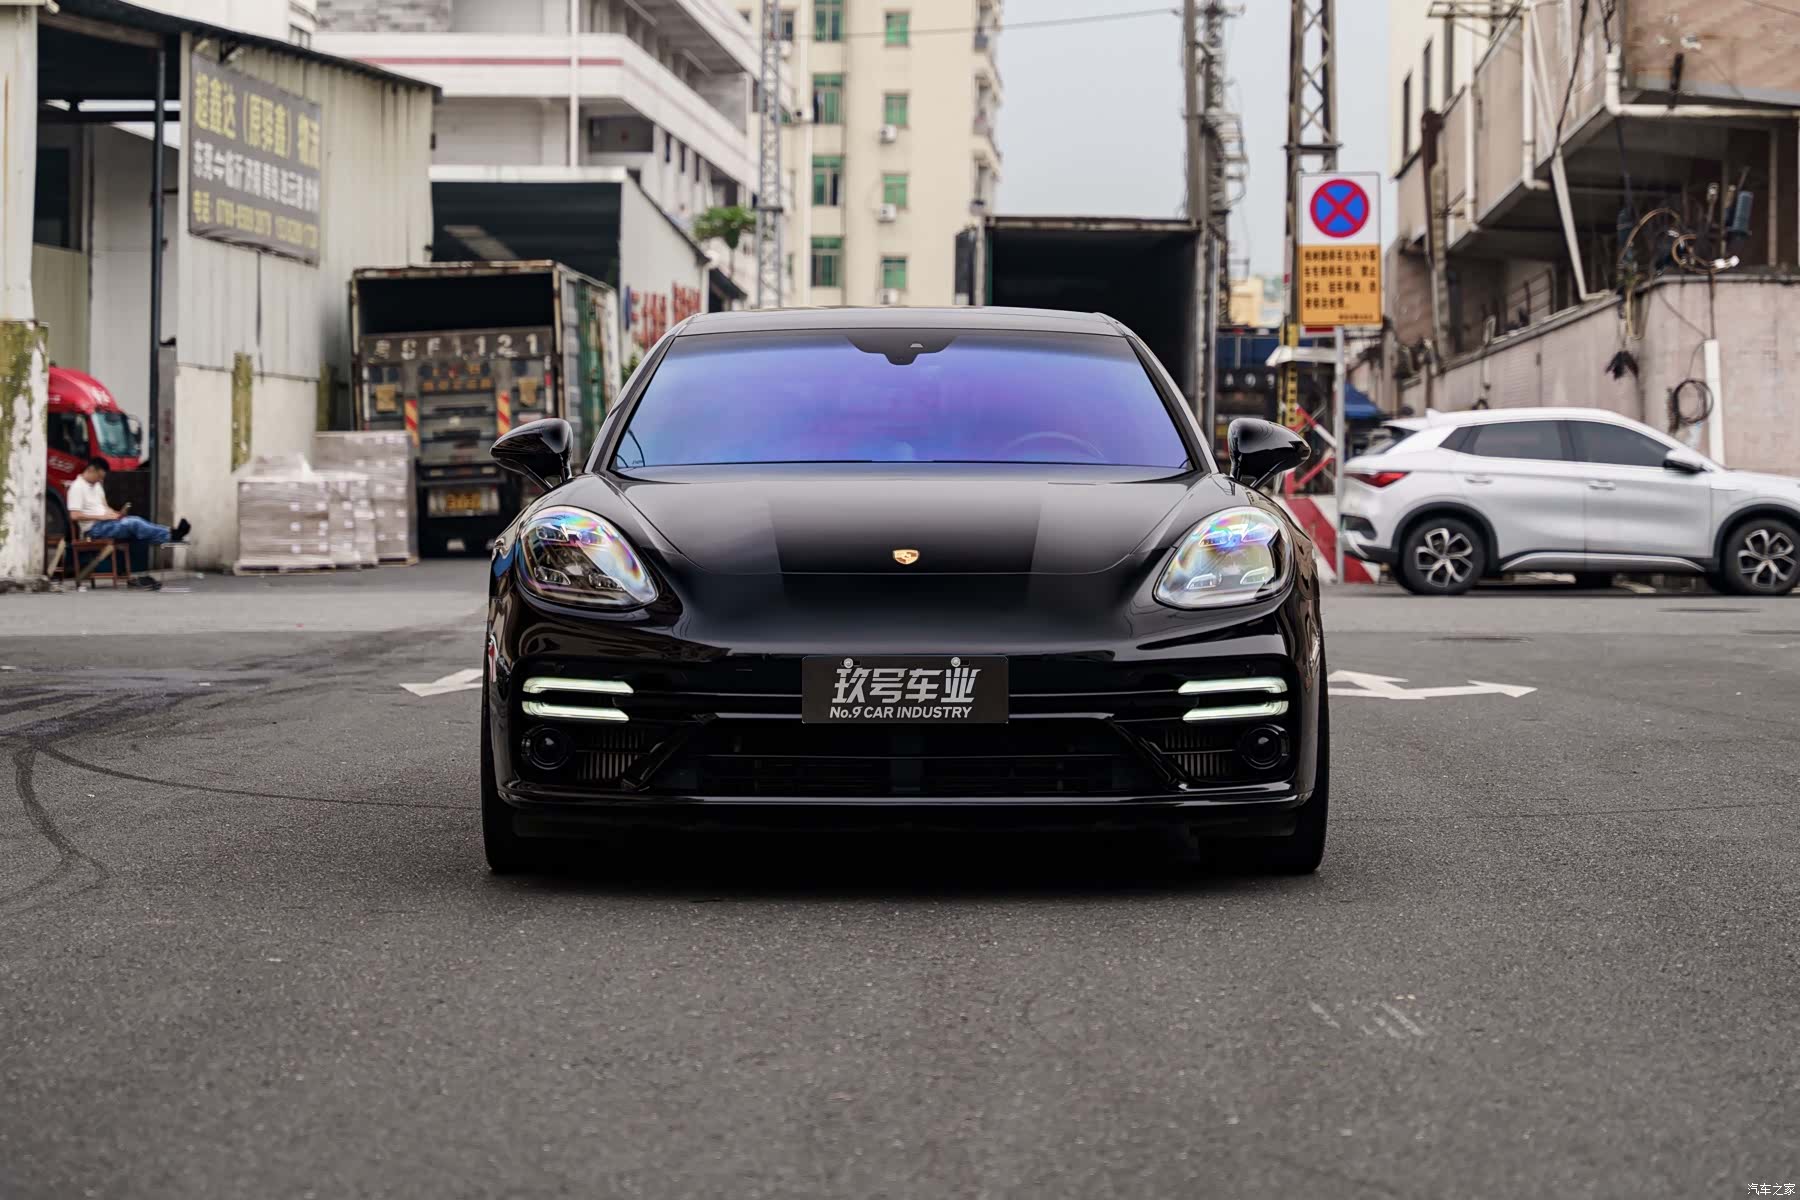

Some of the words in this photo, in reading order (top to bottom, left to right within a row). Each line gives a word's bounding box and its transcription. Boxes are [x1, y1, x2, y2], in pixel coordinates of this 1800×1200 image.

[832, 667, 982, 704] 玖号车业
[829, 706, 863, 719] No.9
[864, 706, 894, 719] CAR
[896, 706, 973, 719] INDUSTRY
